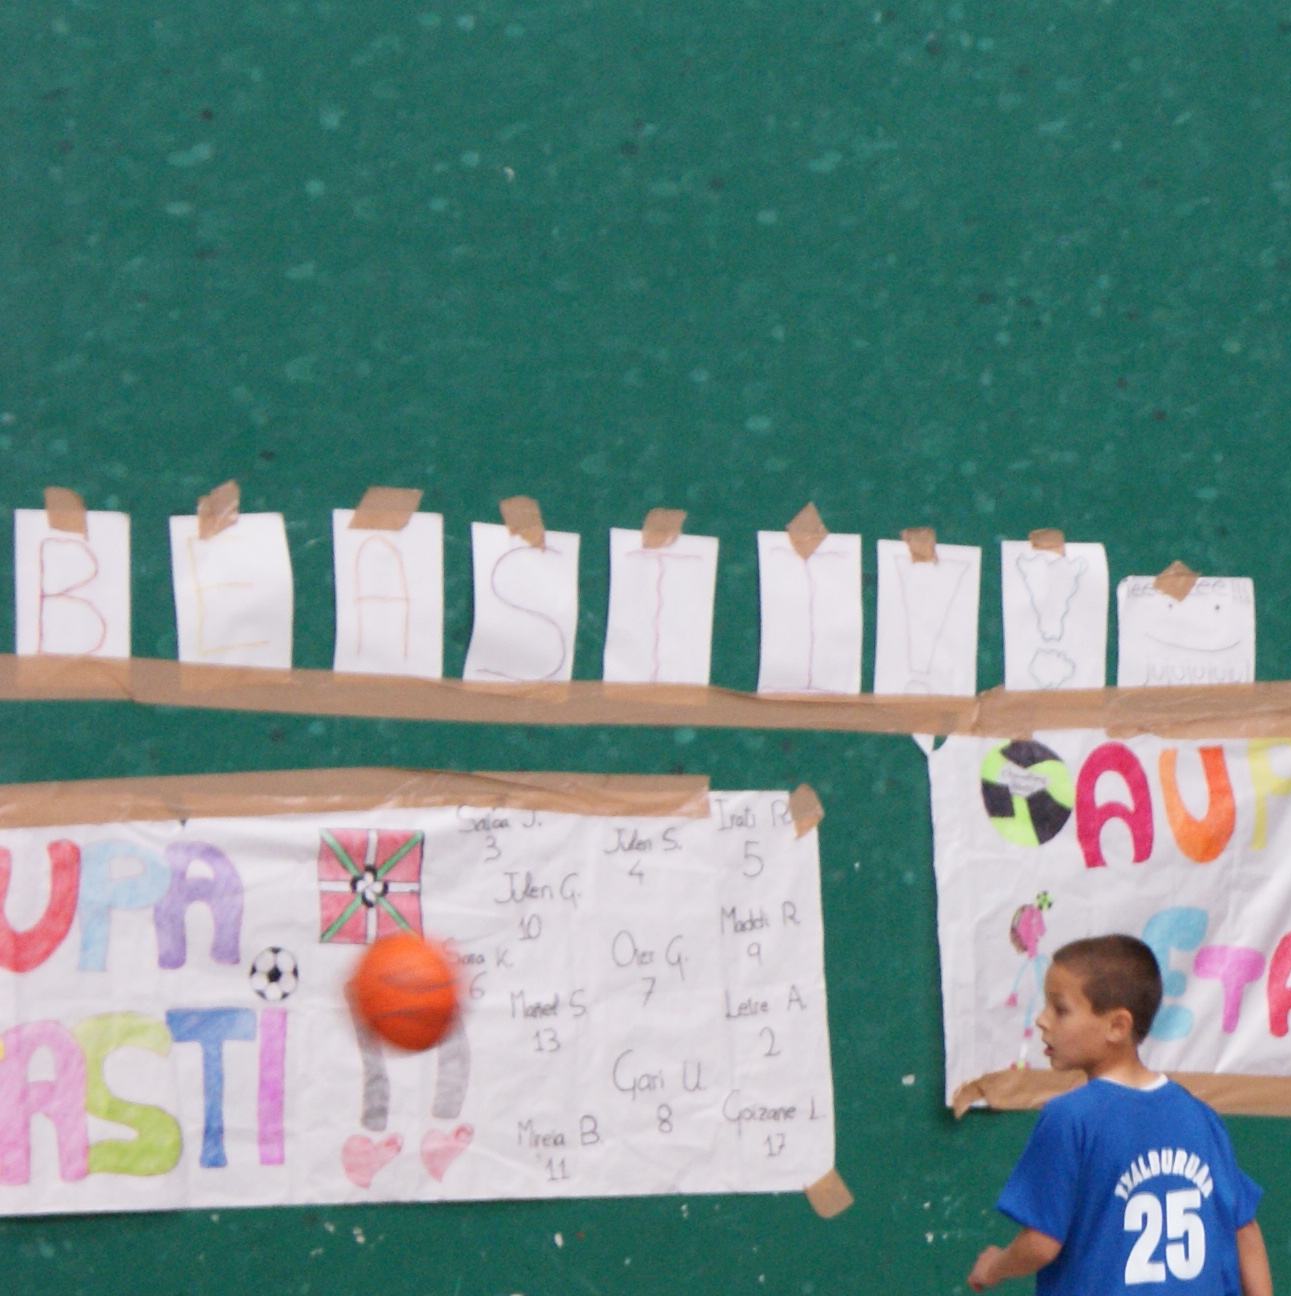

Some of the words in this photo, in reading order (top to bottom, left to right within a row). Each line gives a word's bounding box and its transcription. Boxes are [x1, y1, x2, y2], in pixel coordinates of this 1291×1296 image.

[484, 834, 502, 862] 3
[742, 840, 765, 879] 5
[627, 859, 645, 886] 4
[518, 913, 543, 941] 10
[746, 942, 763, 967] 9
[469, 970, 488, 1000] 6
[640, 976, 657, 1007] 7
[533, 1027, 562, 1052] 13
[758, 1026, 783, 1057] 2
[656, 1102, 674, 1135] 8
[543, 1156, 571, 1183] 11
[1123, 1188, 1207, 1285] 25
